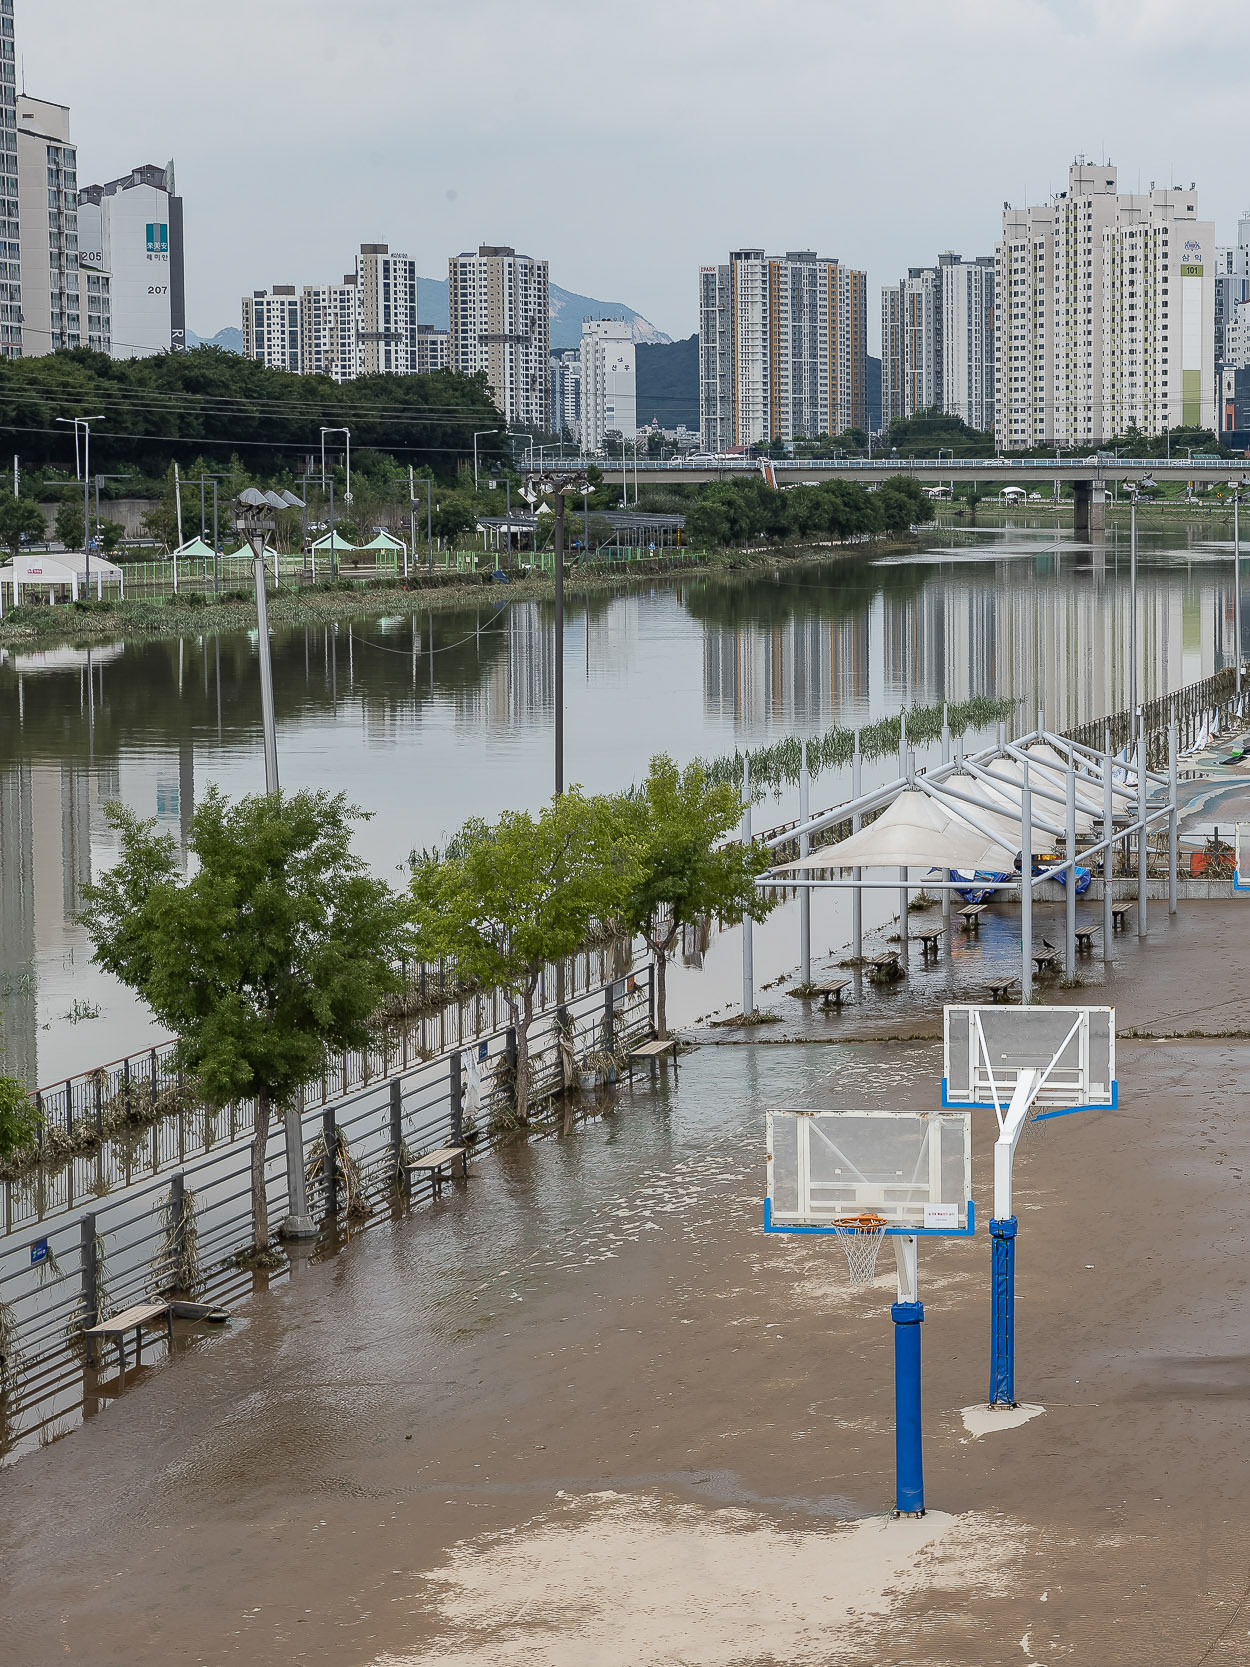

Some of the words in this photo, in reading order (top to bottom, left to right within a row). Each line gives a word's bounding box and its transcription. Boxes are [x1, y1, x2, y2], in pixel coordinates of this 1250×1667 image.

[81, 251, 102, 261] 205
[1186, 266, 1198, 274] 101
[147, 286, 168, 294] 207
